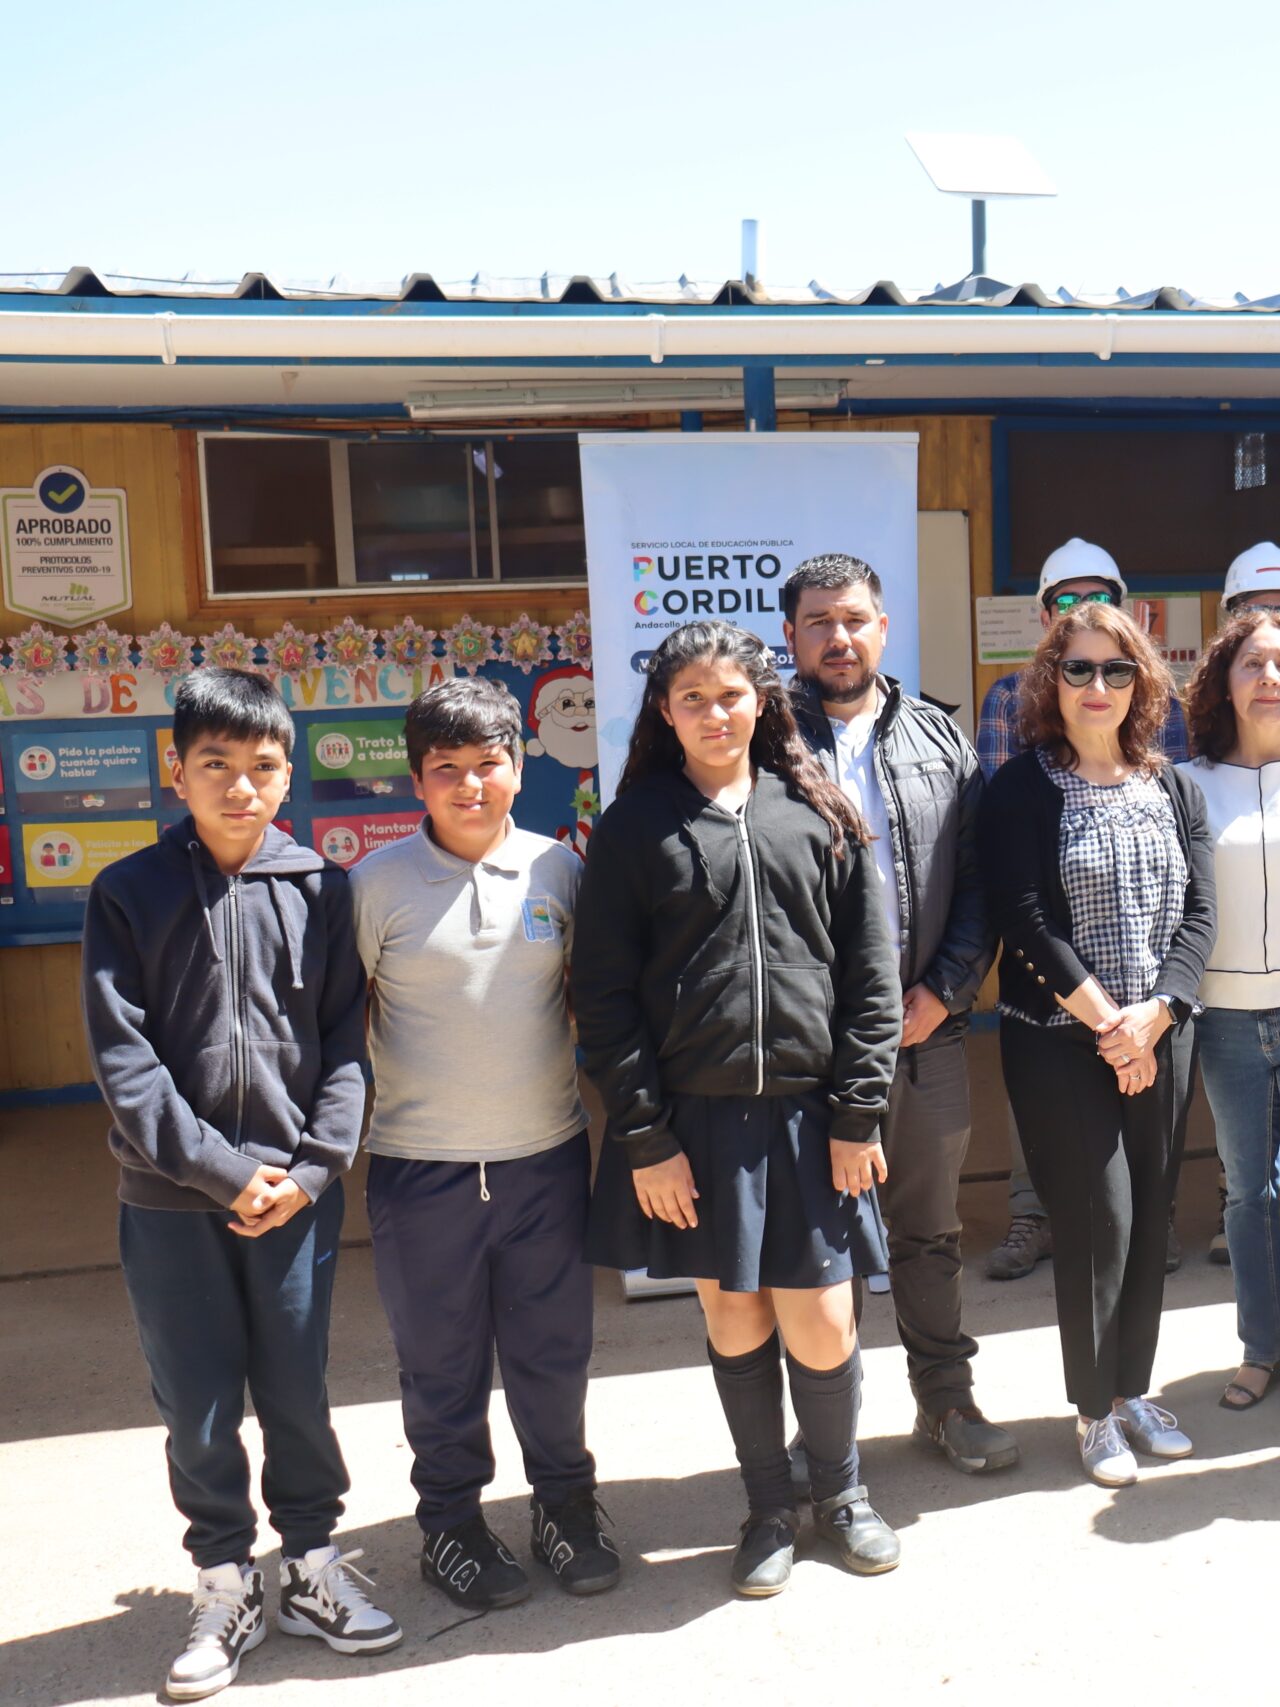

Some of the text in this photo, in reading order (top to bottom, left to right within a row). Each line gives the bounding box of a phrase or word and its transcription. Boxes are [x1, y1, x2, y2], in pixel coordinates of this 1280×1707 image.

[16, 518, 111, 534] APROBADO
[16, 537, 113, 546] 100% CUMPLIMIENTO
[710, 539, 759, 547] EDUCACIÓN
[40, 556, 92, 564] PROTOCOLOS
[22, 566, 74, 574] PREVENTIVOS
[632, 553, 781, 582] PUERTO
[634, 621, 681, 629] Andacollo
[82, 673, 137, 713] DE
[356, 736, 394, 748] Trato
[59, 745, 141, 757] Pido la palabra
[370, 748, 408, 760] todos
[60, 756, 137, 767] cuando quiero
[60, 768, 97, 777] hablar
